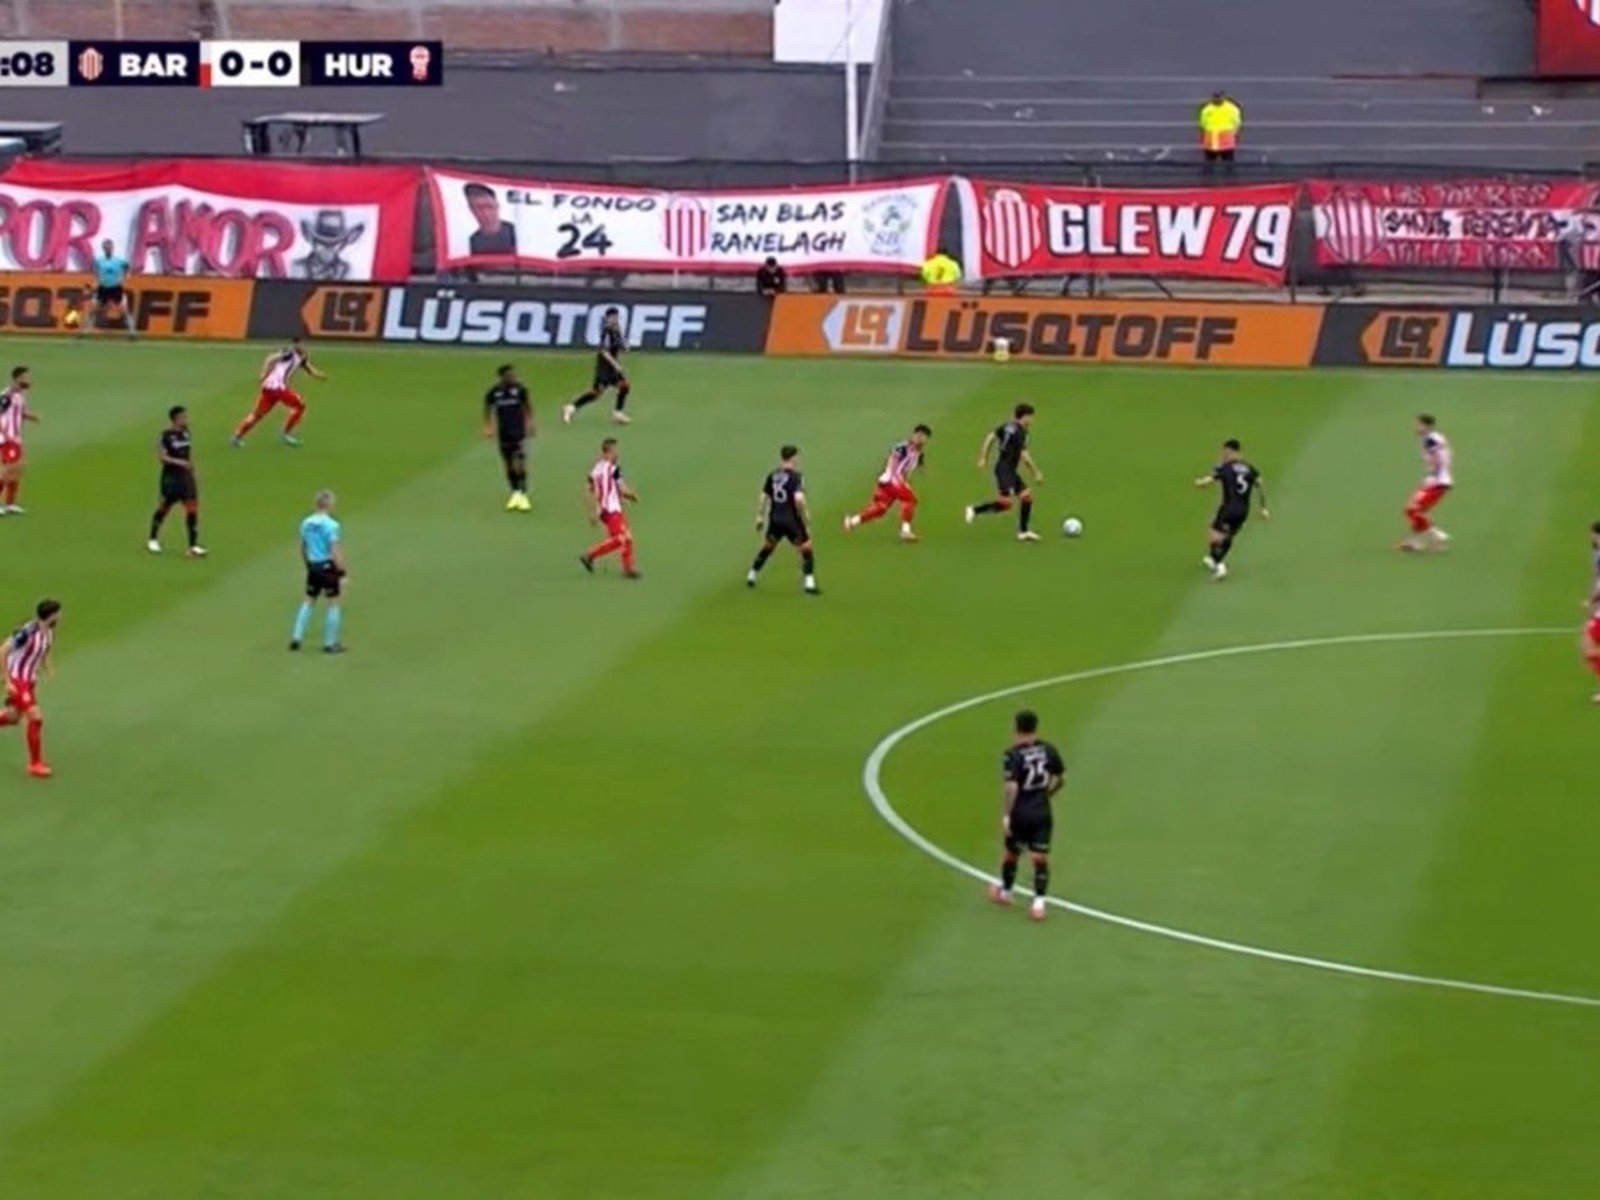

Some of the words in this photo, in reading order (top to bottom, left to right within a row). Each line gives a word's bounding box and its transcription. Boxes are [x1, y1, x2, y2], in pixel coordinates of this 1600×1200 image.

[507, 189, 542, 205] EL
[553, 194, 657, 211] FONDO
[717, 203, 768, 224] SAN
[776, 201, 846, 222] BLAS
[131, 196, 295, 278] AMOR
[556, 222, 614, 259] 24
[711, 231, 847, 255] RANELAGH
[1047, 202, 1216, 257] GLEW
[1222, 202, 1293, 268] 79
[383, 286, 707, 348] LÜSQTOFF
[905, 299, 1238, 360] LÜSQTOFF
